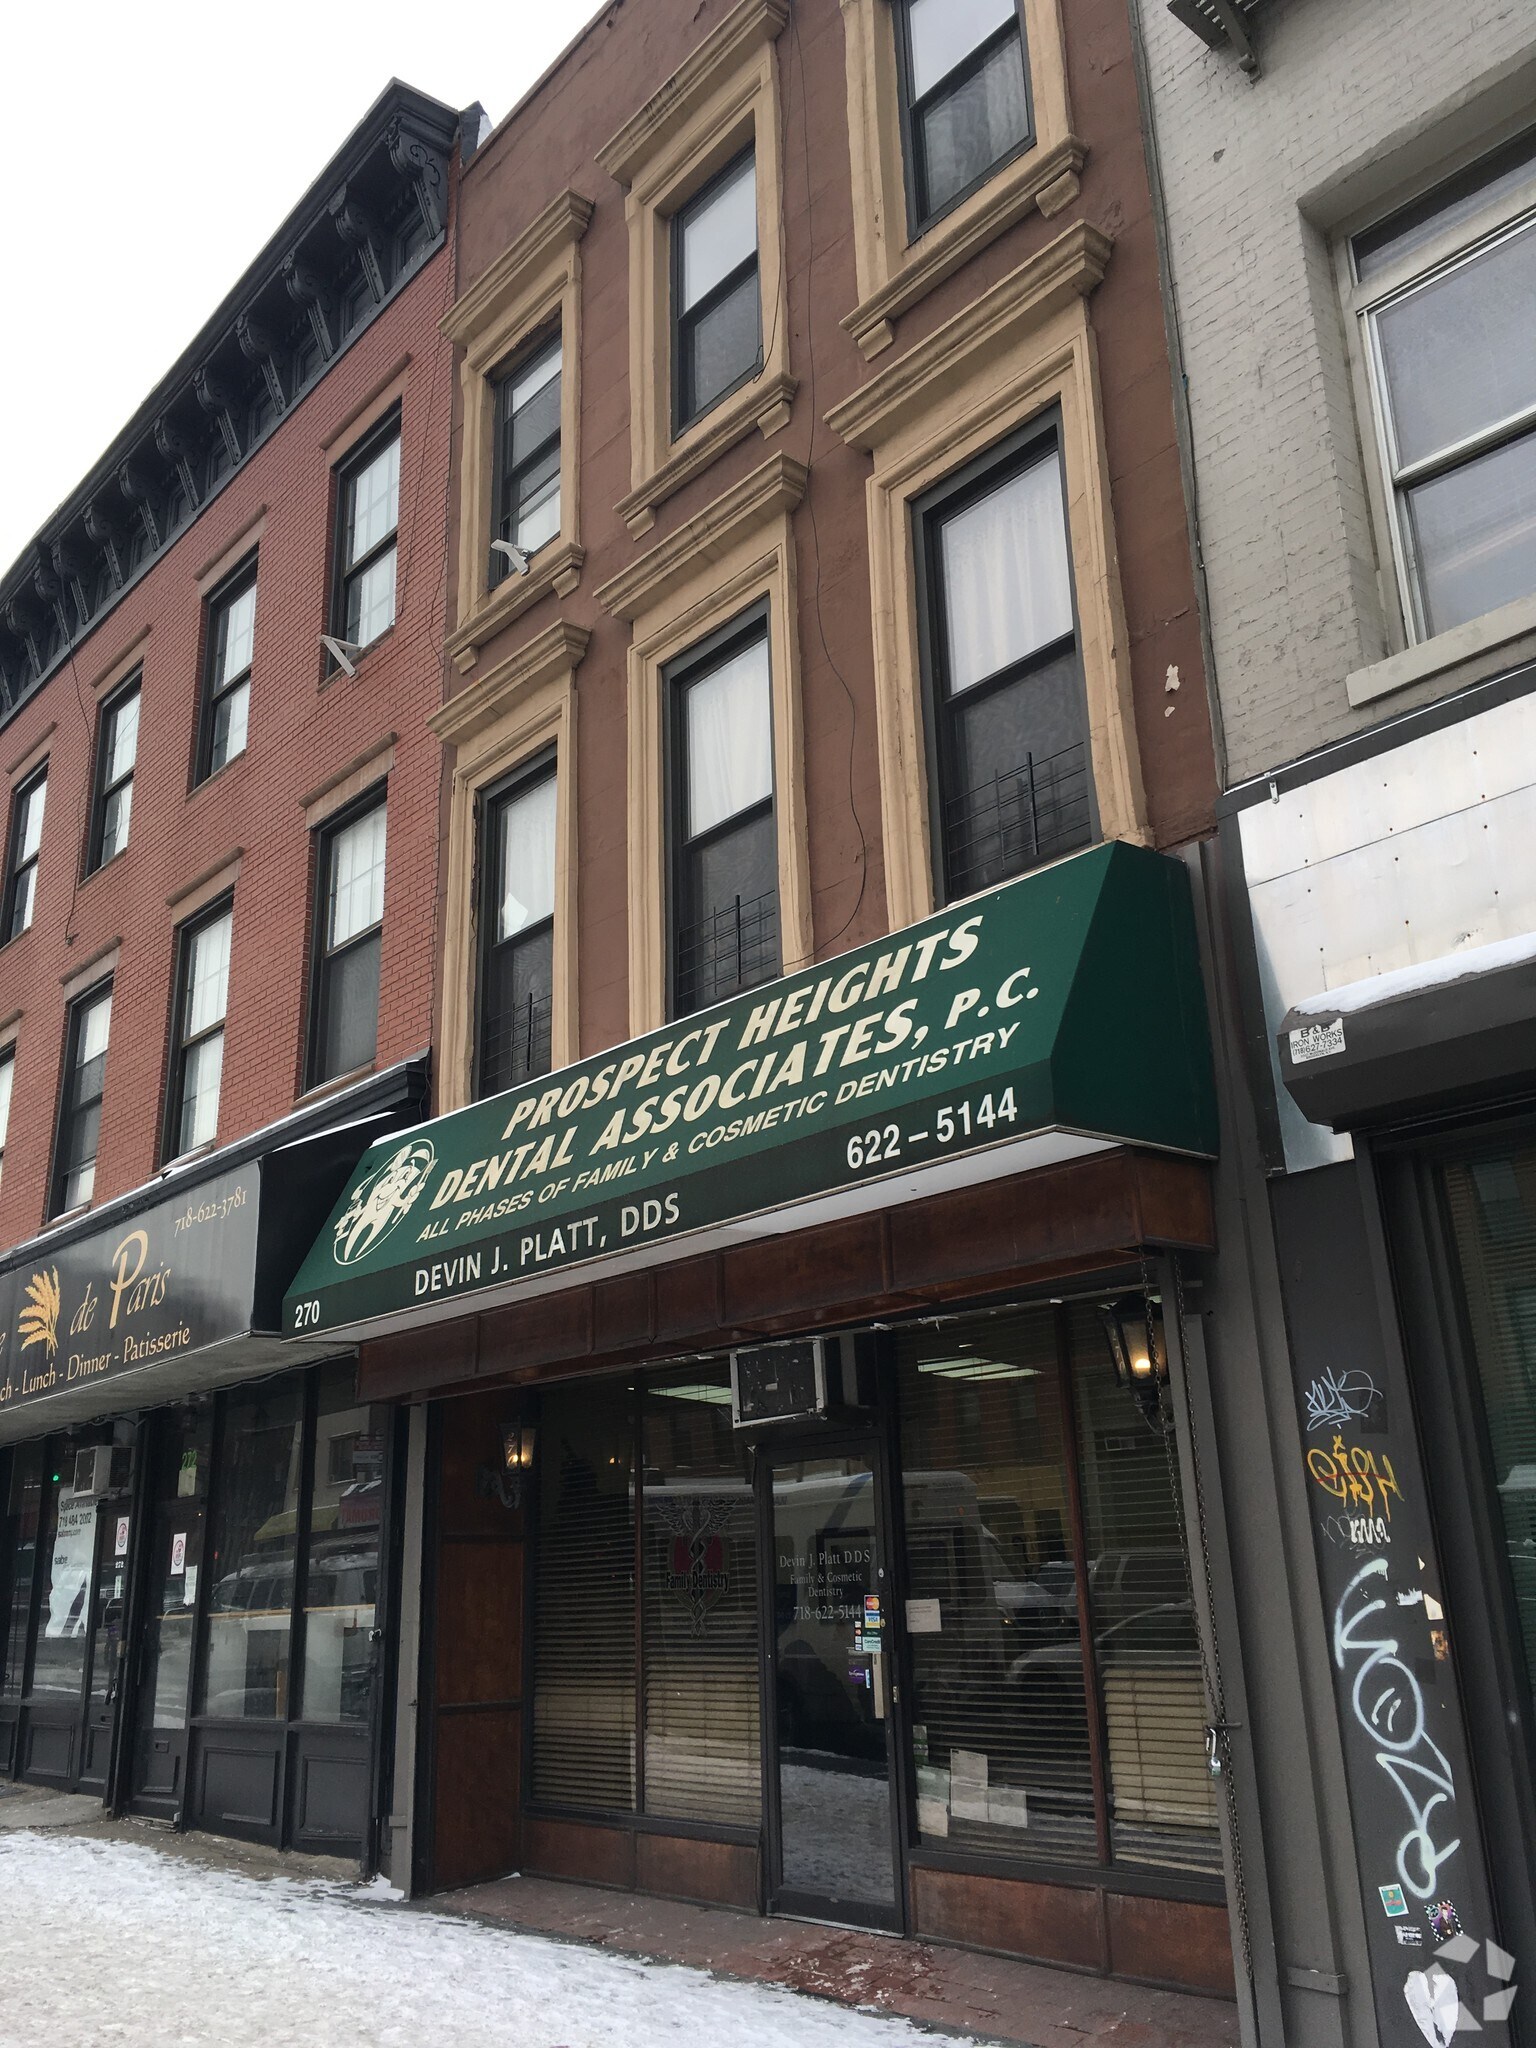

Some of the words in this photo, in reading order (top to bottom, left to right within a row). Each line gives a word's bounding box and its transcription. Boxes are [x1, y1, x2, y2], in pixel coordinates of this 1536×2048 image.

[501, 1018, 731, 1141] PROSPECT
[737, 915, 983, 1051] HEIGHTS
[1312, 1028, 1343, 1043] WORKS
[429, 1126, 579, 1211] DENTAL
[588, 999, 929, 1156] ASSOCIATES,
[944, 967, 1039, 1029] P.C.
[416, 1217, 450, 1244] ALL
[455, 1190, 534, 1231] PHASES
[538, 1178, 571, 1204] OF
[572, 1147, 659, 1193] FAMILY
[661, 1141, 680, 1163] &
[688, 1091, 828, 1156] COSMETIC
[834, 1022, 1021, 1106] DENTISTRY
[173, 1186, 248, 1238] 718-622-3781
[414, 1246, 481, 1297] DEVIN
[491, 1246, 509, 1276] J.
[520, 1216, 608, 1266] PLATT,
[620, 1192, 681, 1238] DDS
[70, 1282, 98, 1336] de
[108, 1229, 172, 1330] Paris
[293, 1299, 321, 1329] 270
[22, 1362, 56, 1395] Lunch
[66, 1351, 112, 1382] Dinner
[123, 1320, 191, 1364] Patisserie
[780, 1554, 806, 1568] Devin
[819, 1550, 841, 1566] Platt
[790, 1572, 815, 1585] Family
[817, 1572, 825, 1583] &
[826, 1570, 862, 1583] Cosmetic
[666, 1572, 691, 1590] Family
[693, 1570, 730, 1593] Dentistry
[808, 1586, 843, 1599] Dentistry
[793, 1603, 862, 1620] 718-622-5144
